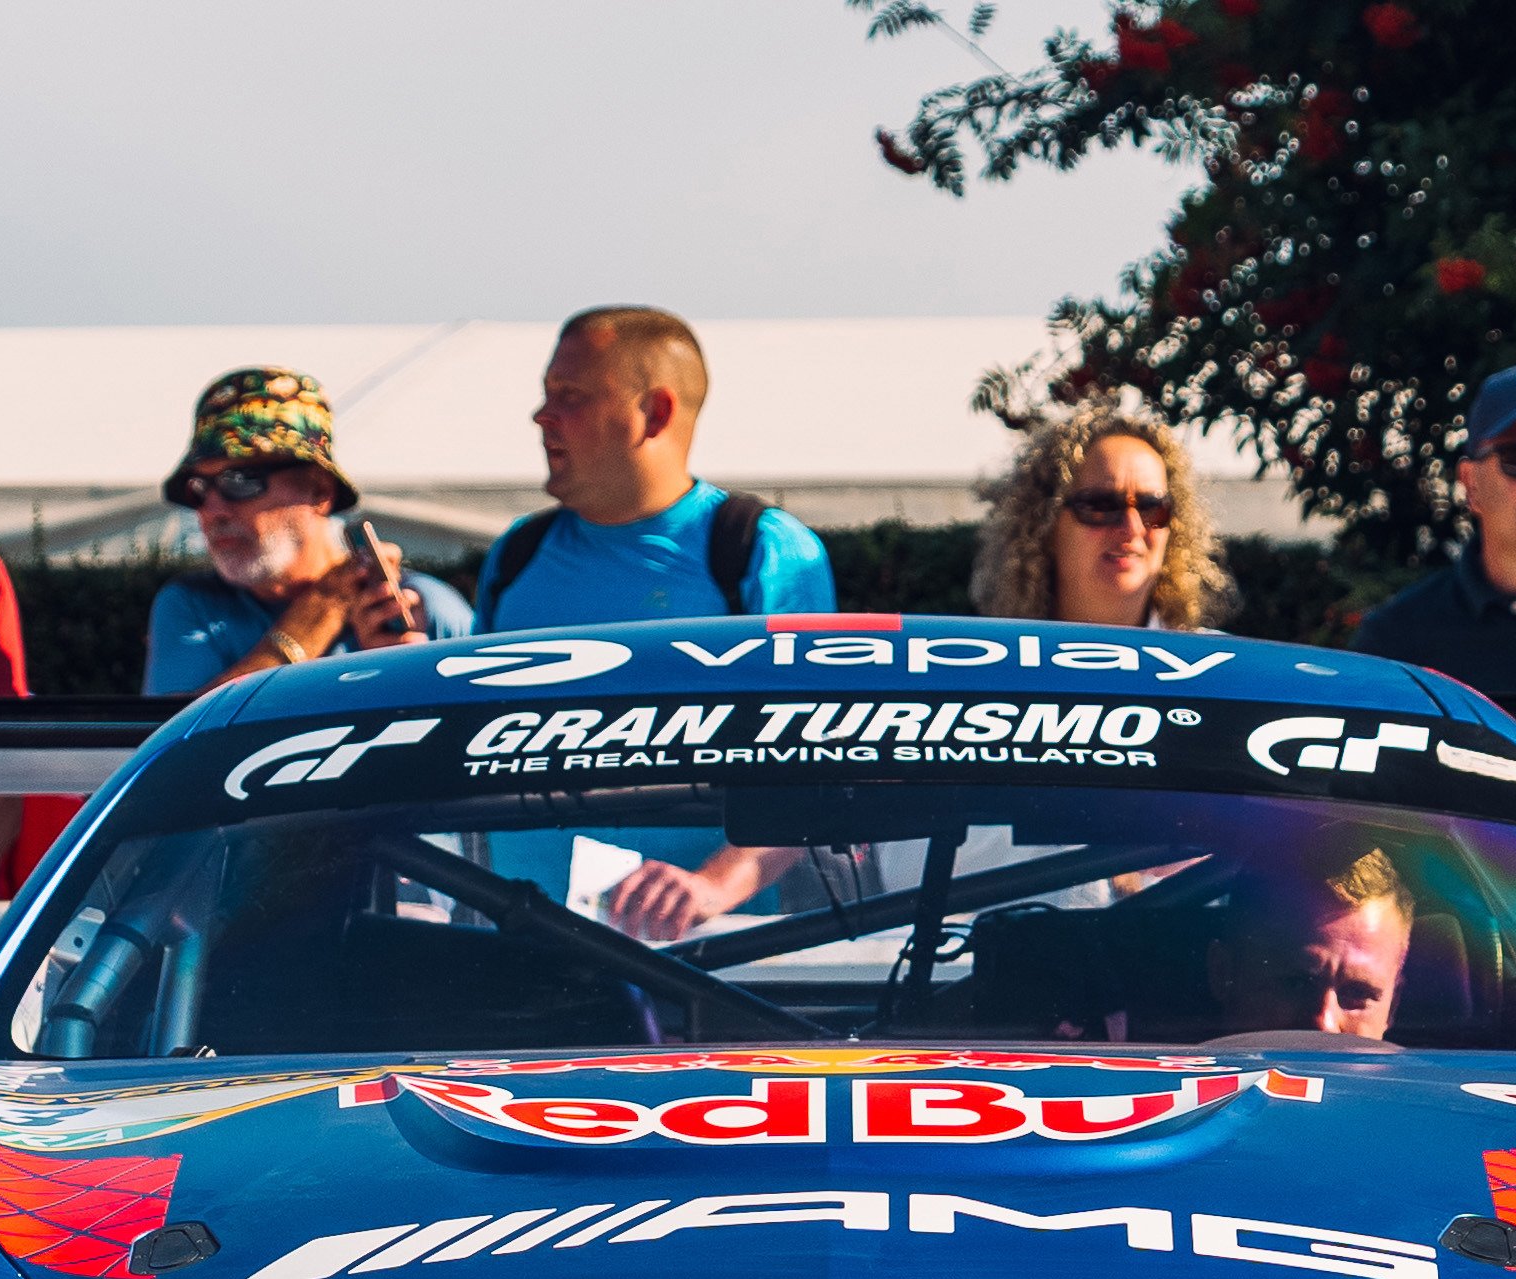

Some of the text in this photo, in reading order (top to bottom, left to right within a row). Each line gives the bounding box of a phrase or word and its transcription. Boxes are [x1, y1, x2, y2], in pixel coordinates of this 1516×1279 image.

[670, 632, 1236, 682] viaplay
[465, 704, 735, 757] GRAN
[463, 745, 1157, 777] THE REAL DRIVING SIMULATOR
[339, 1074, 826, 1145] Red
